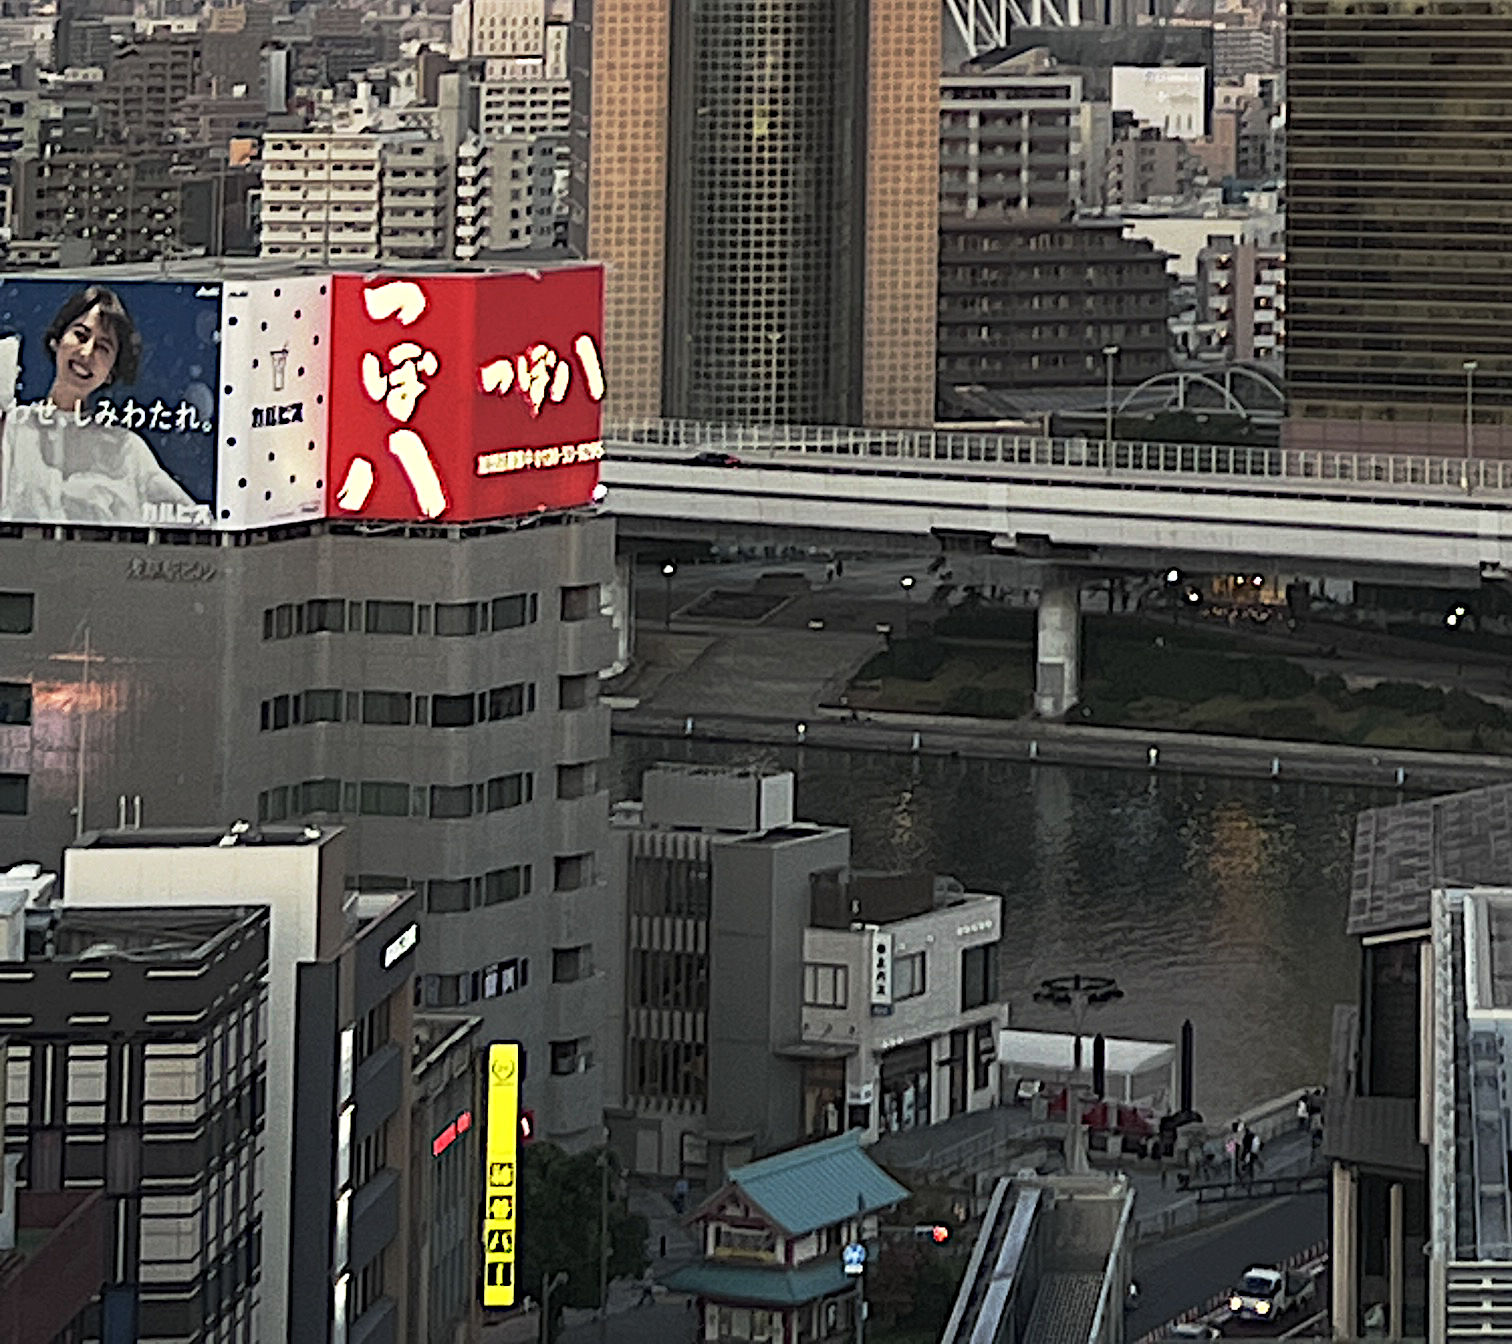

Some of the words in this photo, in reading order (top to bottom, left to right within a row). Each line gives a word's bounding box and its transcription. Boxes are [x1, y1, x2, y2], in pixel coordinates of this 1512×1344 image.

[0, 399, 212, 432] わせ、しみわたれ。
[337, 281, 447, 519] つぼ八
[480, 334, 606, 418] つぼ八
